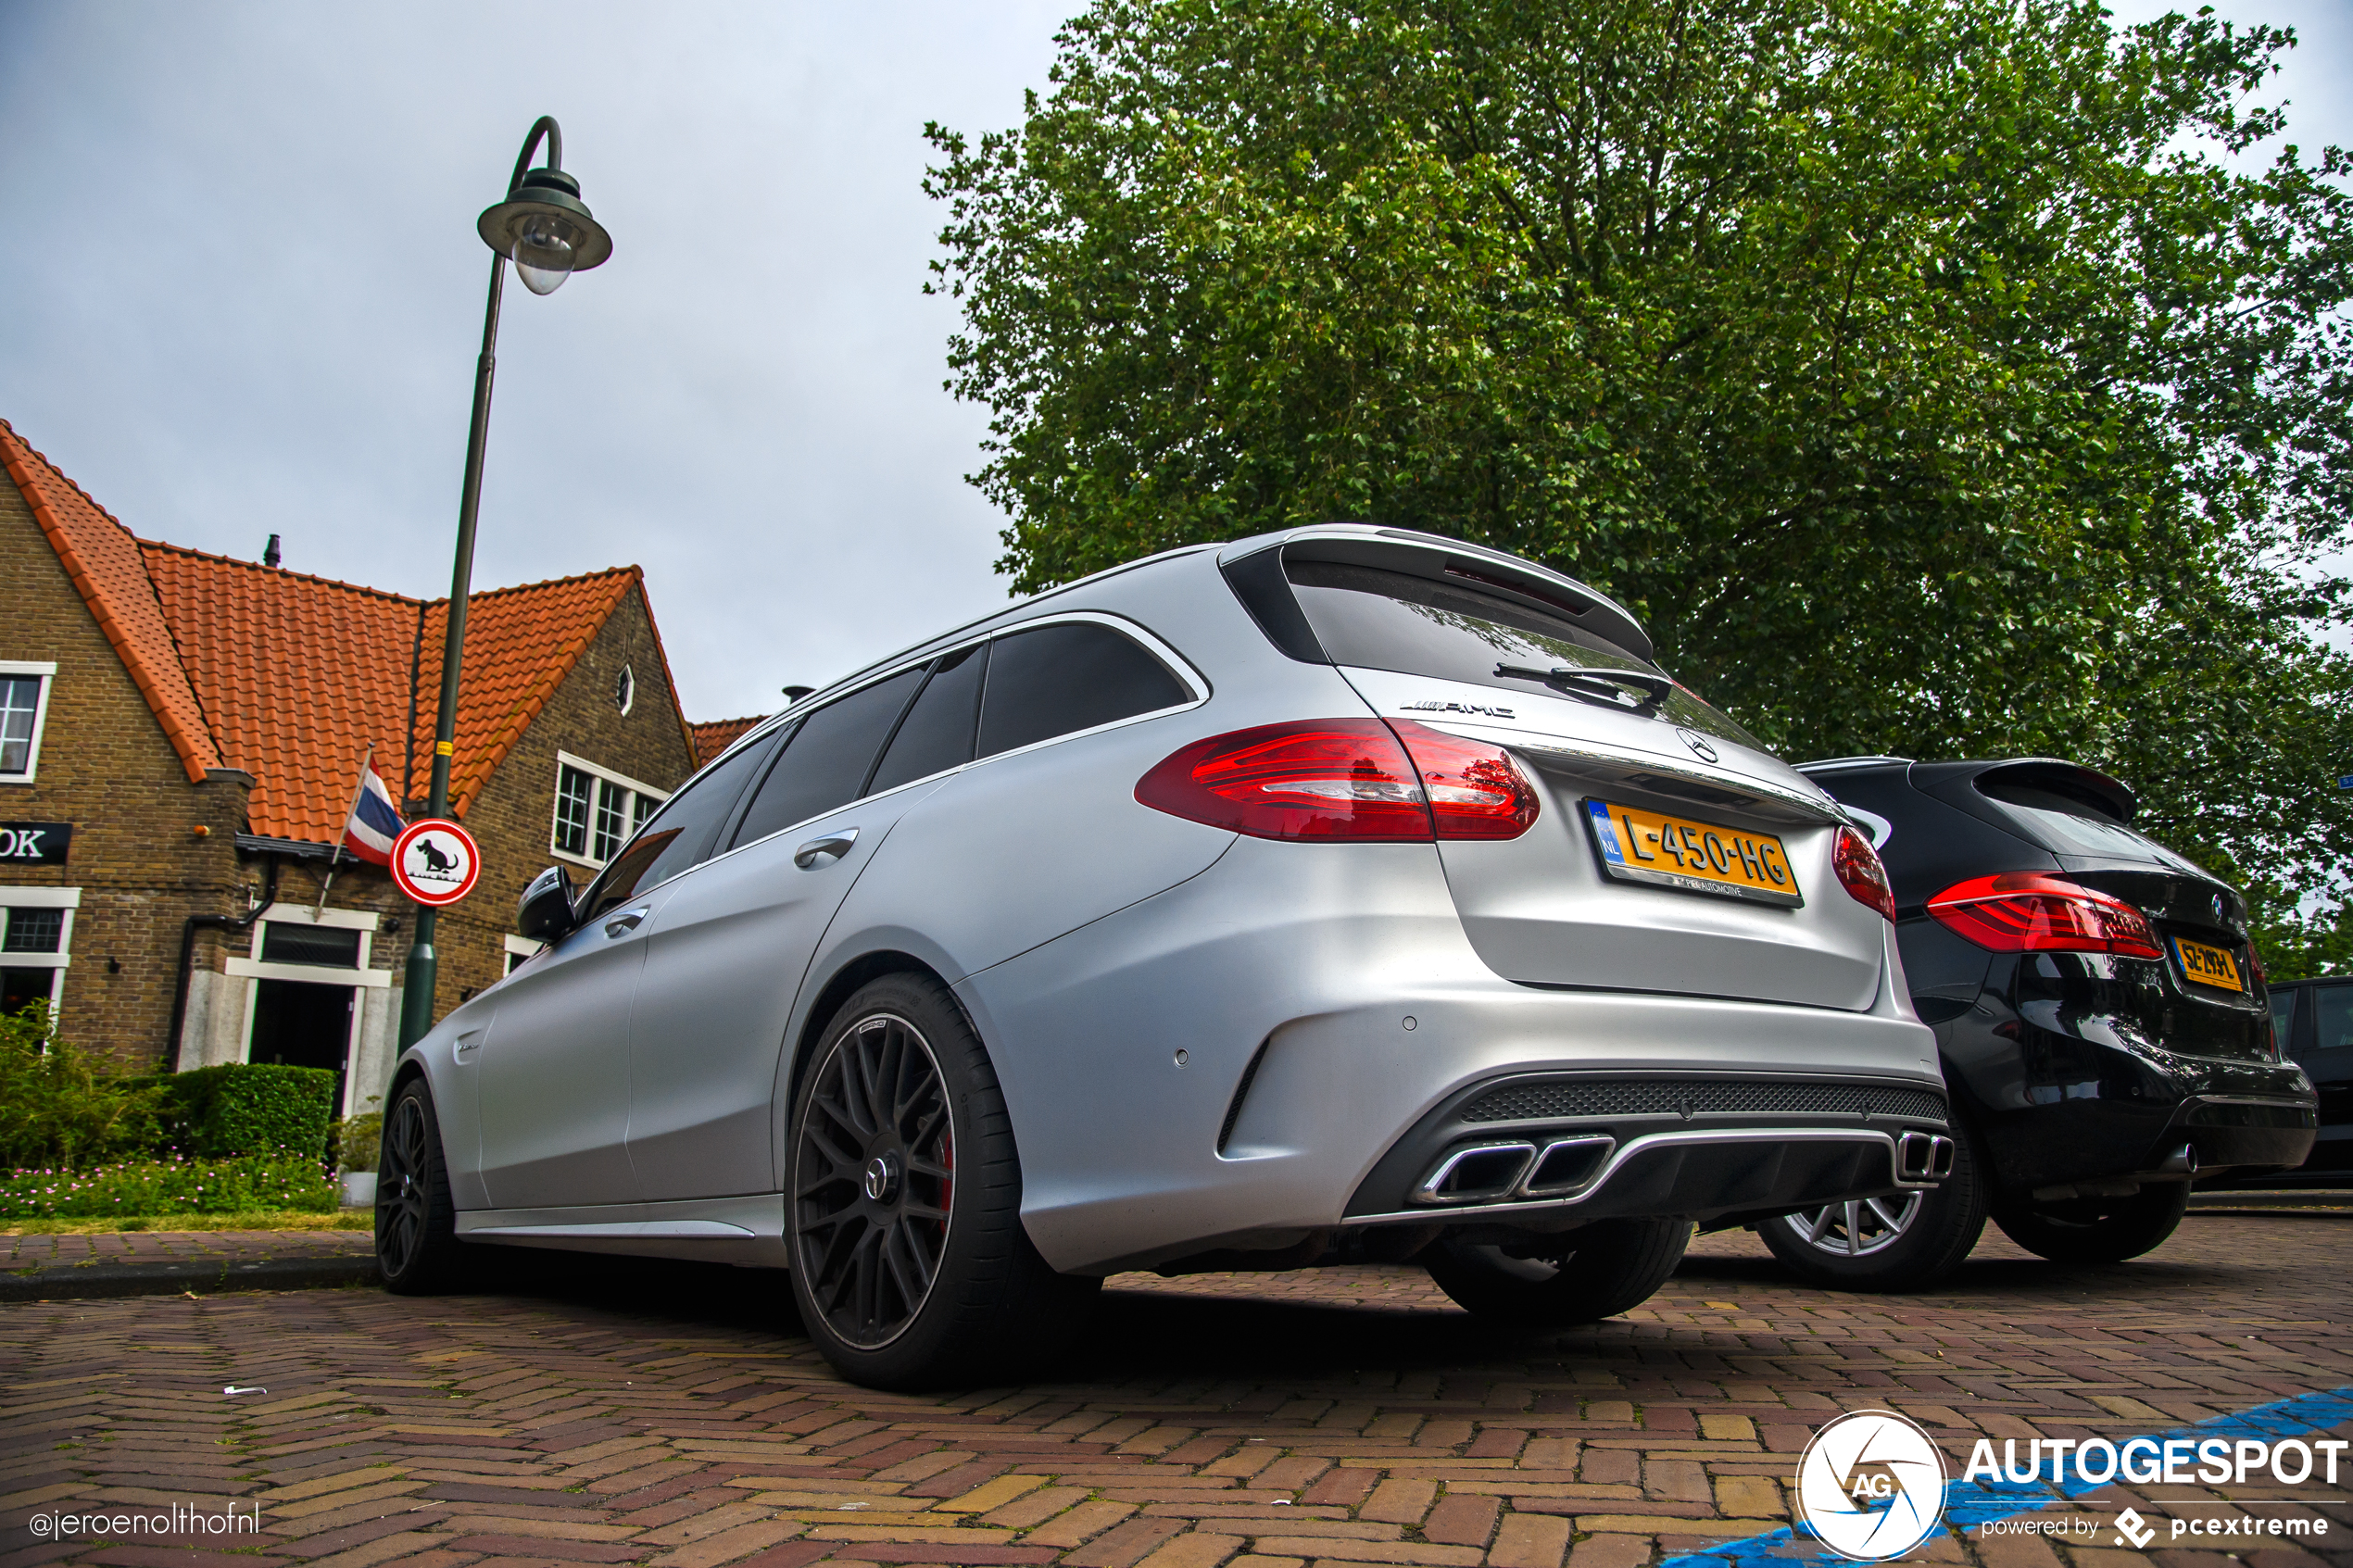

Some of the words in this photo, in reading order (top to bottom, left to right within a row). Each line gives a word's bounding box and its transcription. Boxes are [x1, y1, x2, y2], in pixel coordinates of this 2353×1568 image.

[1445, 702, 1516, 719] AMG
[1603, 839, 1620, 855] NL
[1622, 814, 1787, 884] L-450-HG
[1701, 881, 1743, 897] AUTOMOTIVE
